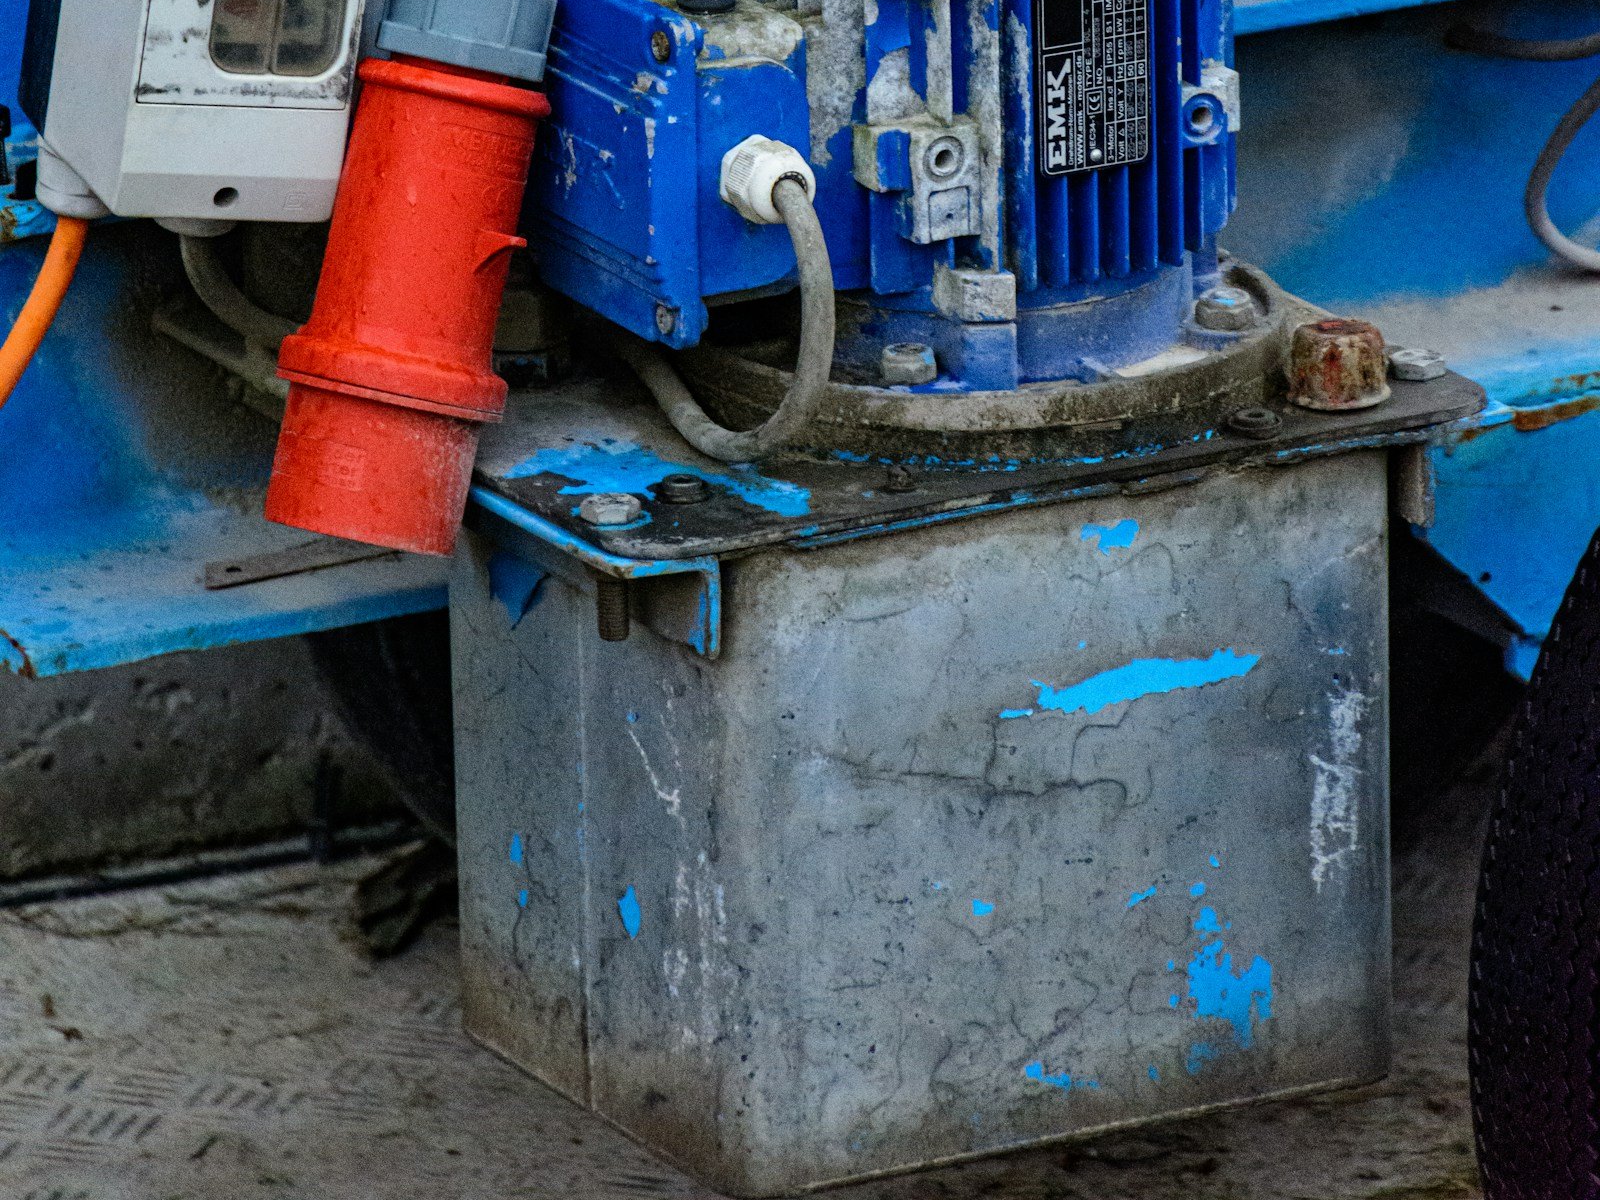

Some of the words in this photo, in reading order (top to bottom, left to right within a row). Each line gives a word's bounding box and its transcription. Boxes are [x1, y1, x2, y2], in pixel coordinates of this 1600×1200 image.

[1106, 0, 1112, 10] IM
[1106, 21, 1112, 33] S1
[1116, 18, 1122, 32] kW
[1117, 39, 1125, 60] rpm
[1117, 66, 1124, 78] Hz
[1128, 65, 1134, 76] 50
[1138, 63, 1144, 75] 60
[1047, 58, 1071, 168] EMK
